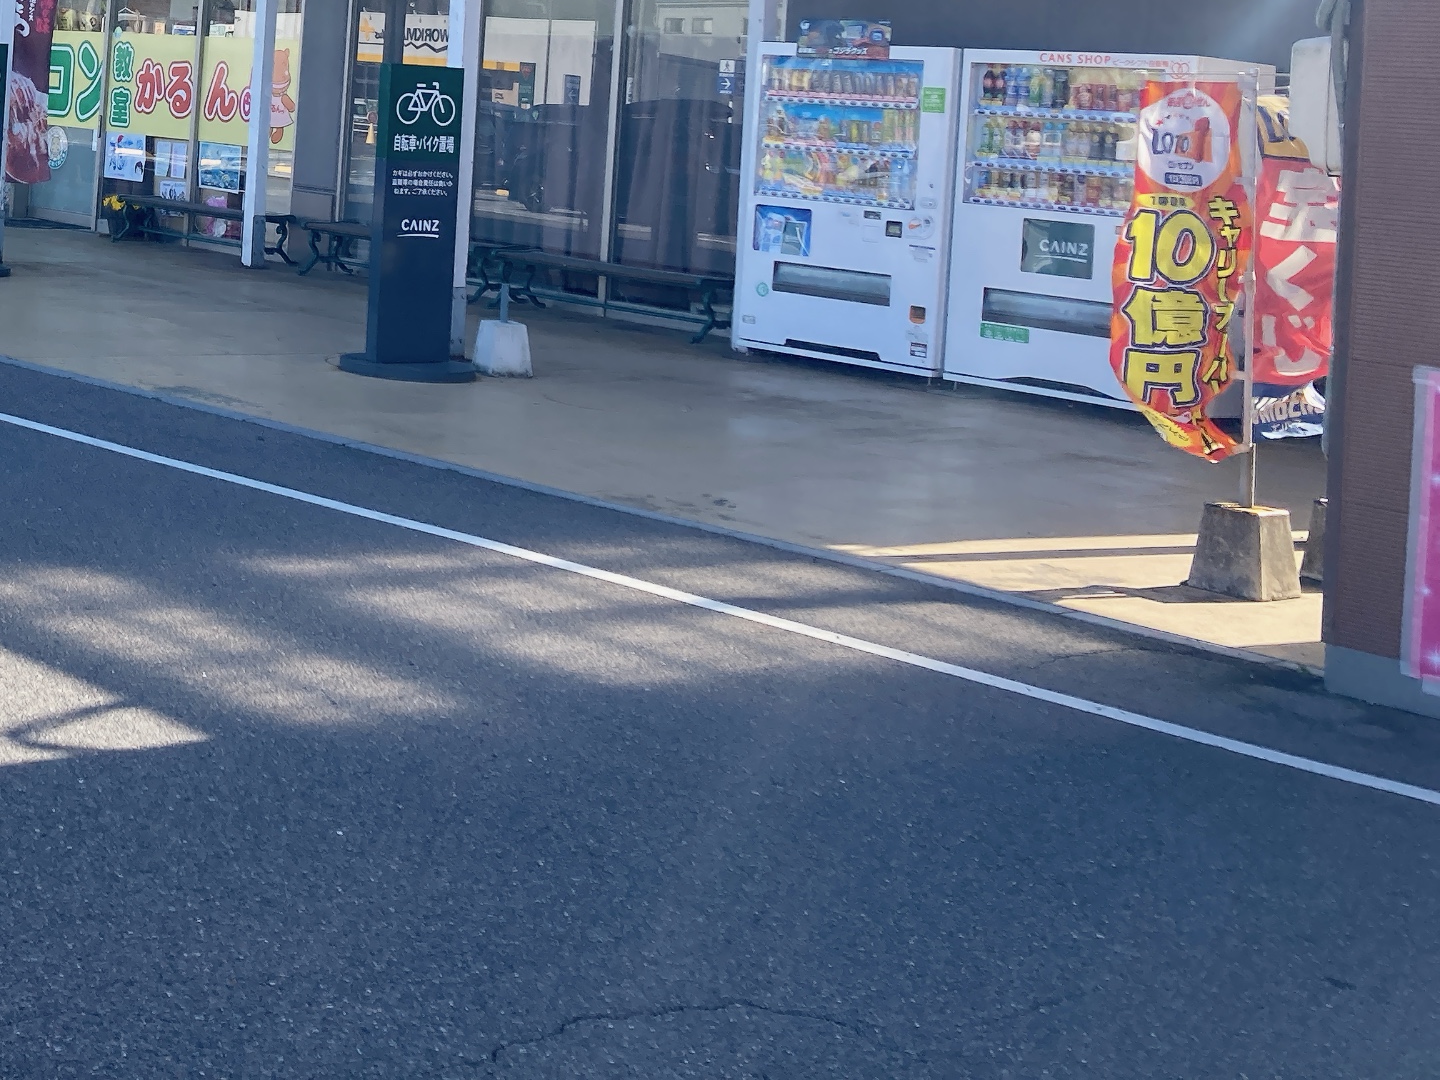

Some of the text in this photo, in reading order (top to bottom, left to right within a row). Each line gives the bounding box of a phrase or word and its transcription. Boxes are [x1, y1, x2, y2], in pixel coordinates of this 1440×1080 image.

[1039, 53, 1111, 65] CANS SHOP
[134, 58, 238, 123] かるん
[393, 133, 454, 153] 自転車・バイク置場
[401, 218, 440, 232] CAINZ
[1039, 237, 1089, 257] CAINZ
[1123, 208, 1218, 407] 10億円
